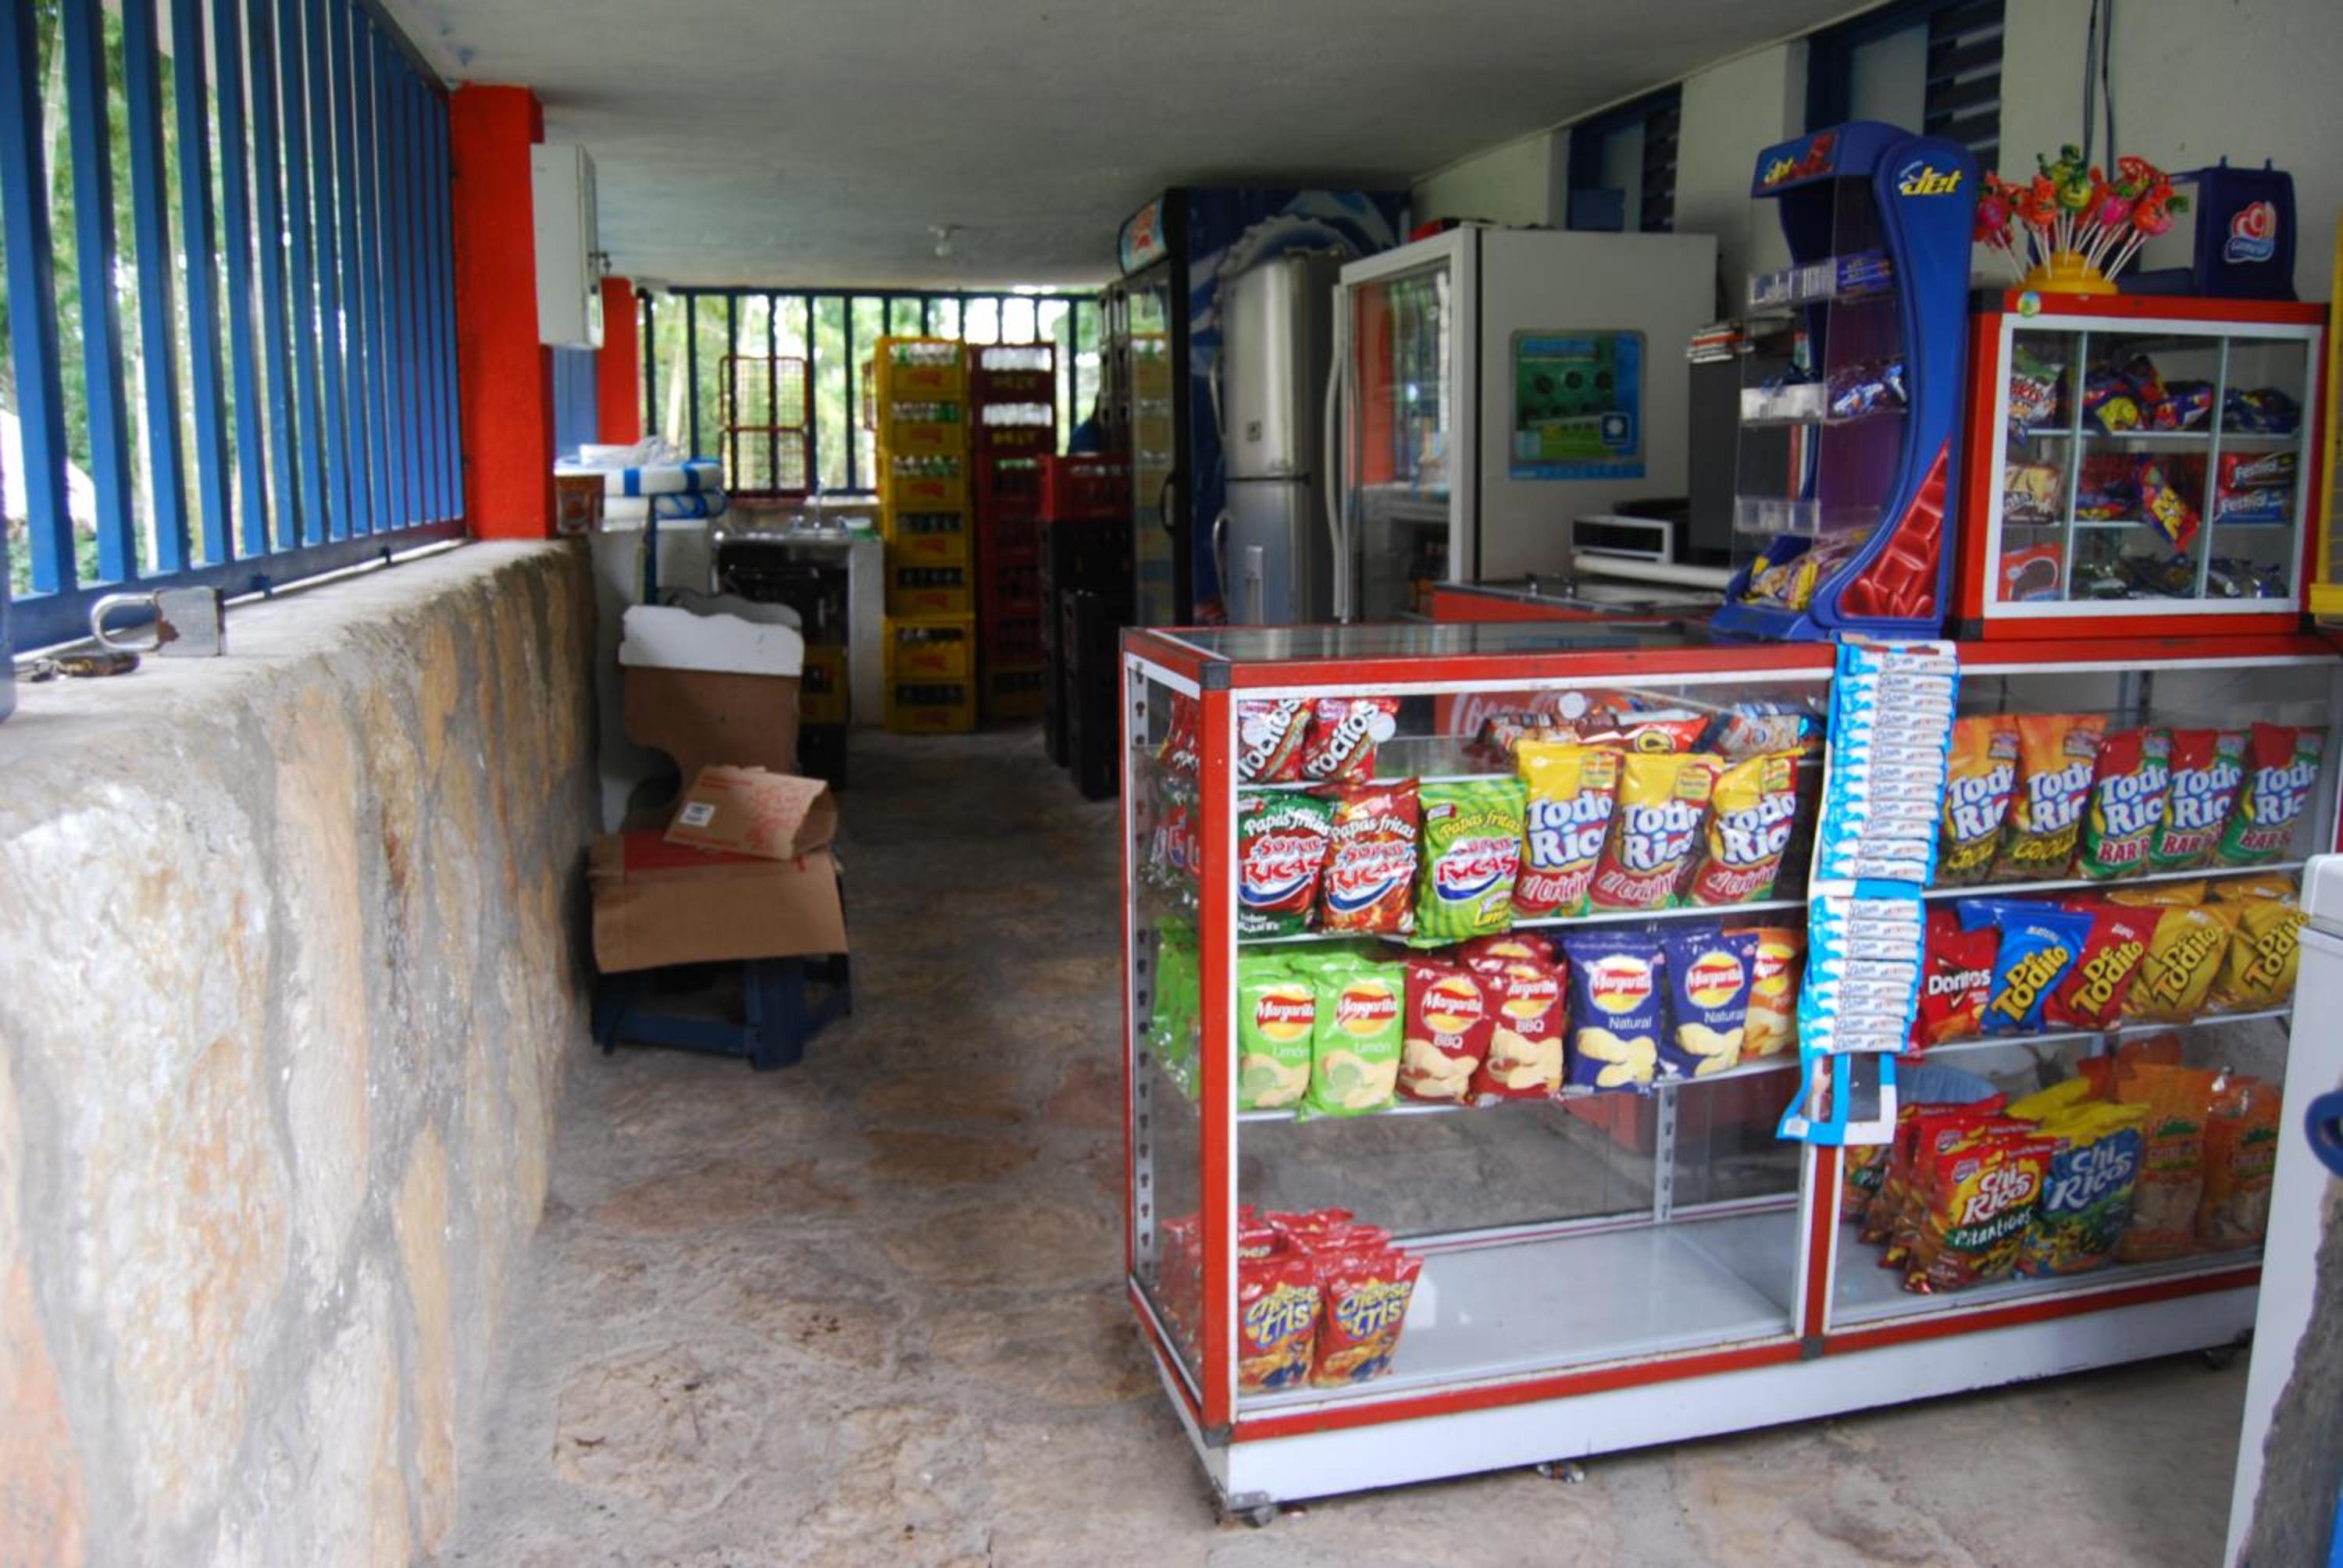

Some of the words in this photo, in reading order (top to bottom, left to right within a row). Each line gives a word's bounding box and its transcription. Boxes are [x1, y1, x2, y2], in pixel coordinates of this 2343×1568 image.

[1901, 166, 1963, 197] Jet
[1528, 790, 1613, 830] Todo
[1244, 812, 1290, 837] Papas
[1330, 818, 1376, 843] Papas
[1375, 814, 1416, 839] fritas
[1440, 814, 1483, 837] Papas
[1484, 811, 1521, 833] fritas
[2099, 840, 2137, 864] BAR
[1438, 856, 1519, 883] RICAS
[1687, 969, 1744, 990] Margarita
[1928, 968, 1991, 995] Doritos
[1991, 945, 2070, 1022] Todito
[2070, 940, 2145, 1015] Todito
[1424, 989, 1482, 1015] Margarita
[1515, 1018, 1546, 1034] BBQ
[1609, 1016, 1653, 1030] Natural
[1704, 1009, 1747, 1025] Natural
[1434, 1033, 1464, 1049] BBQ
[1962, 1182, 2029, 1225] Ricos
